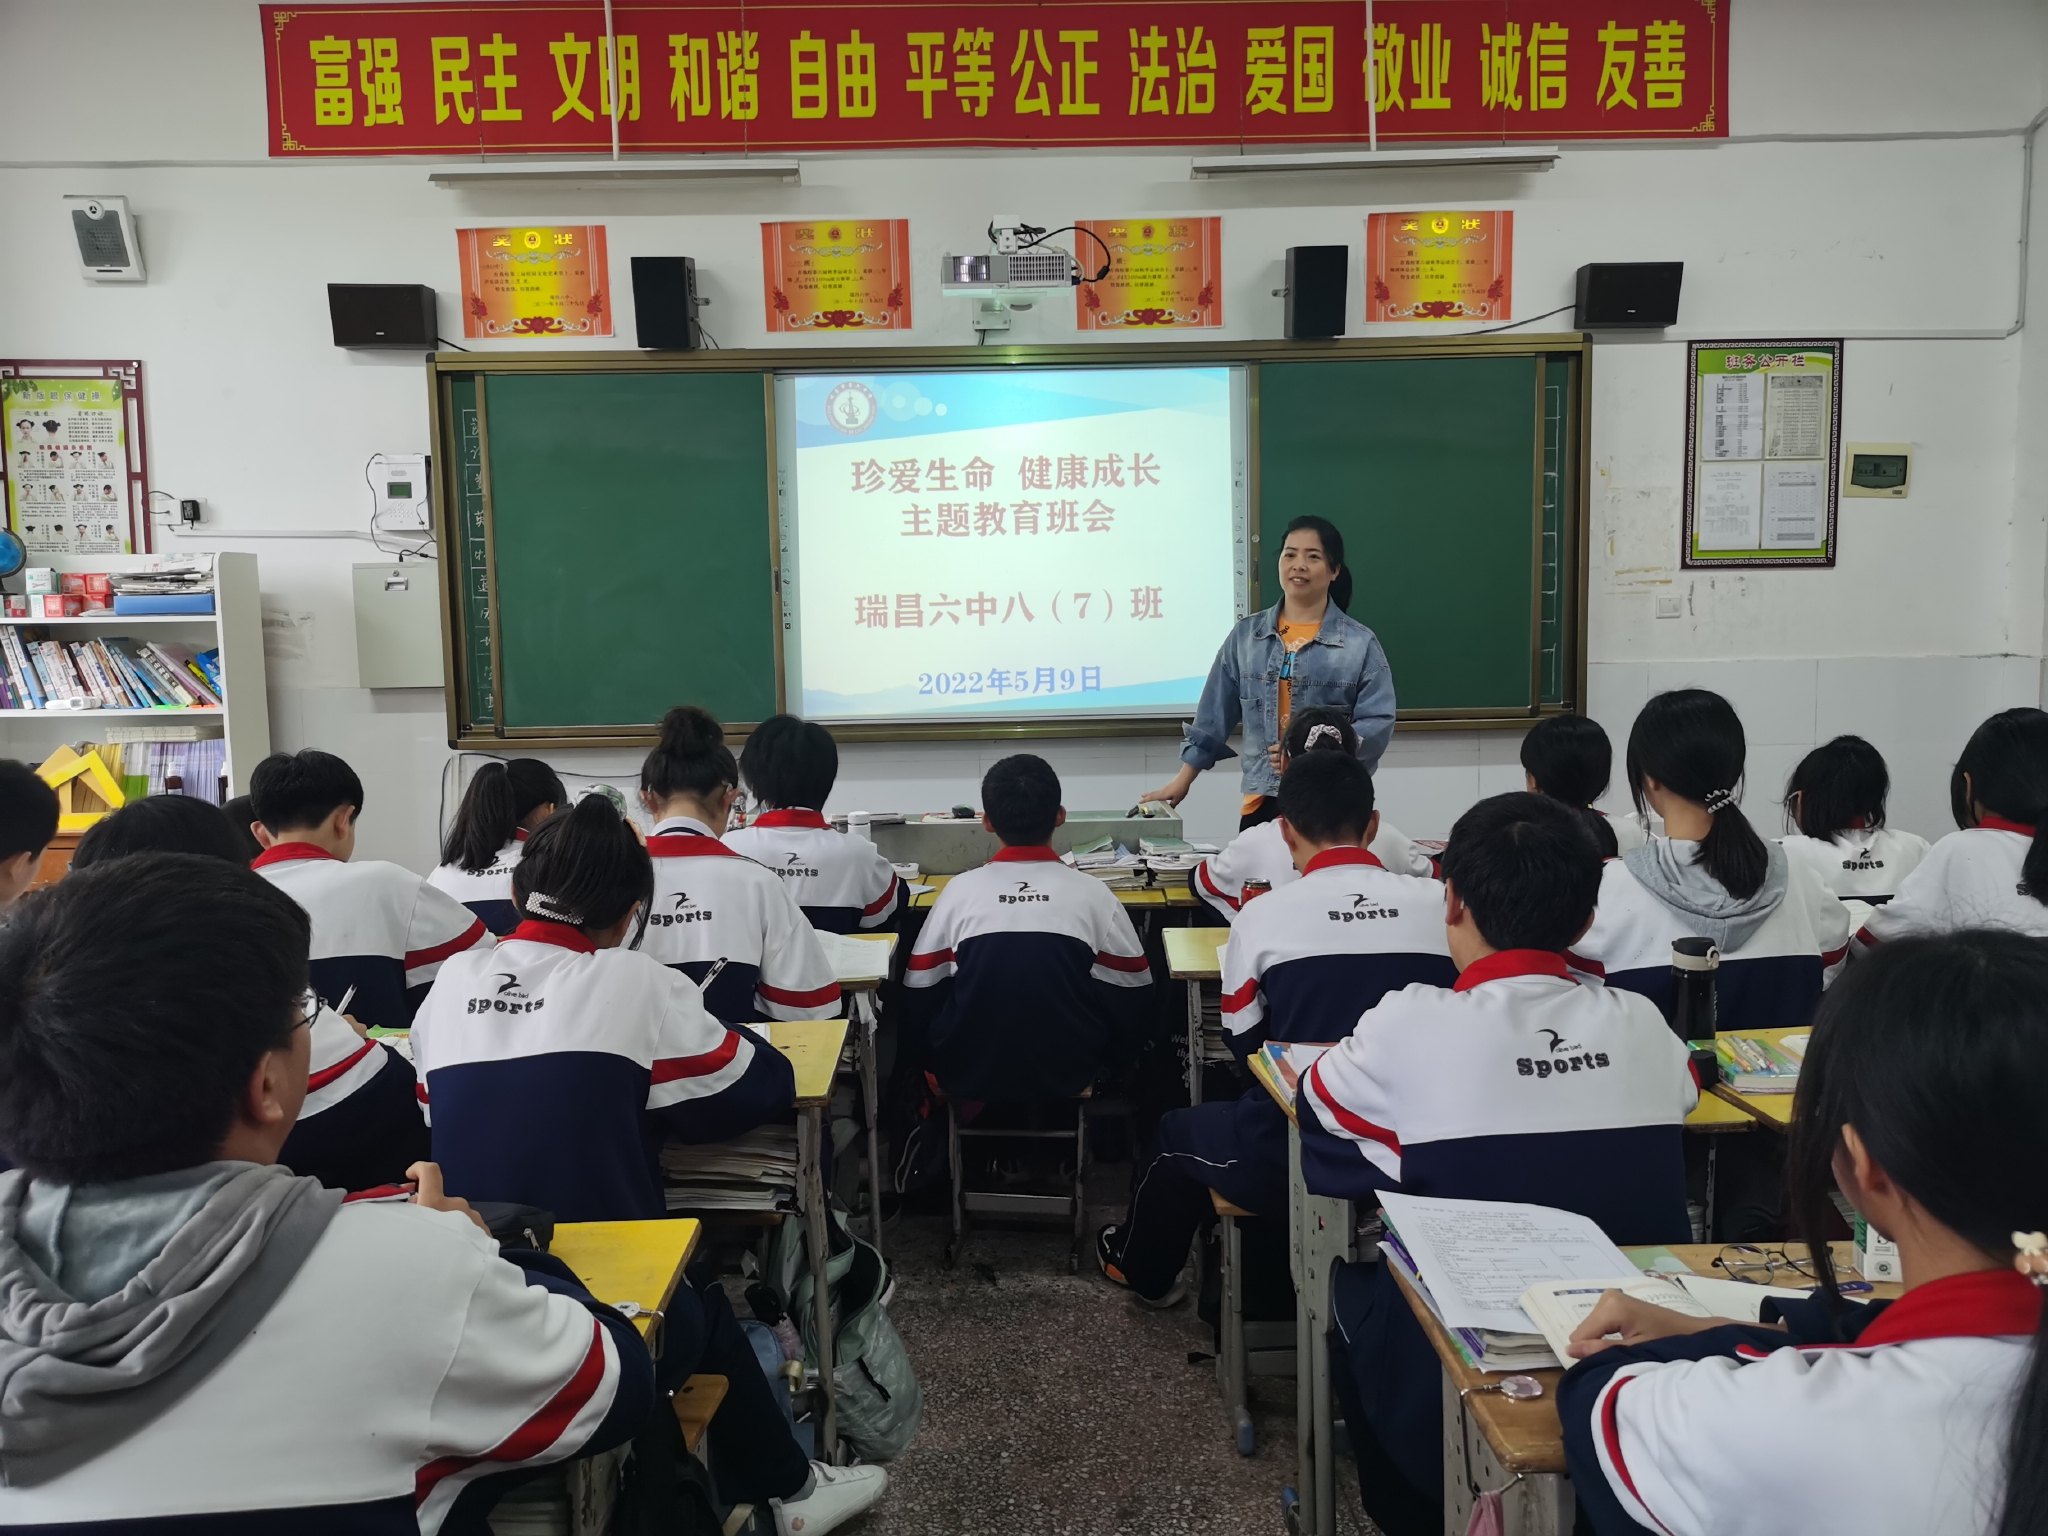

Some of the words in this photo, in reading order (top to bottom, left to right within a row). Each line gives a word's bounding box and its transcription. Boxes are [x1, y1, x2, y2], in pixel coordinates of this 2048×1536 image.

[310, 35, 404, 127] 富强
[431, 33, 522, 125] 民主
[549, 32, 641, 123] 文明
[668, 30, 760, 122] 和谐
[790, 29, 877, 119] 自由
[906, 27, 995, 119] 平等
[1010, 28, 1100, 116] 公正
[1129, 26, 1217, 116] 法治
[1245, 26, 1334, 115] 爱国
[1363, 23, 1452, 113] 敬业
[1480, 22, 1569, 111] 诚信
[1596, 20, 1686, 110] 友善
[1725, 354, 1806, 369] 班务公开栏
[851, 456, 996, 495] 珍爱生命
[1018, 453, 1161, 491] 健康成长
[900, 498, 1116, 538] 主题教育班会
[854, 586, 1164, 629] 瑞昌六中八（7）班
[918, 666, 1102, 696] 2022年5月9日
[998, 894, 1050, 904] Sports
[650, 910, 713, 927] Sports
[1328, 908, 1399, 923] Sports
[1516, 1052, 1610, 1079] Sports
